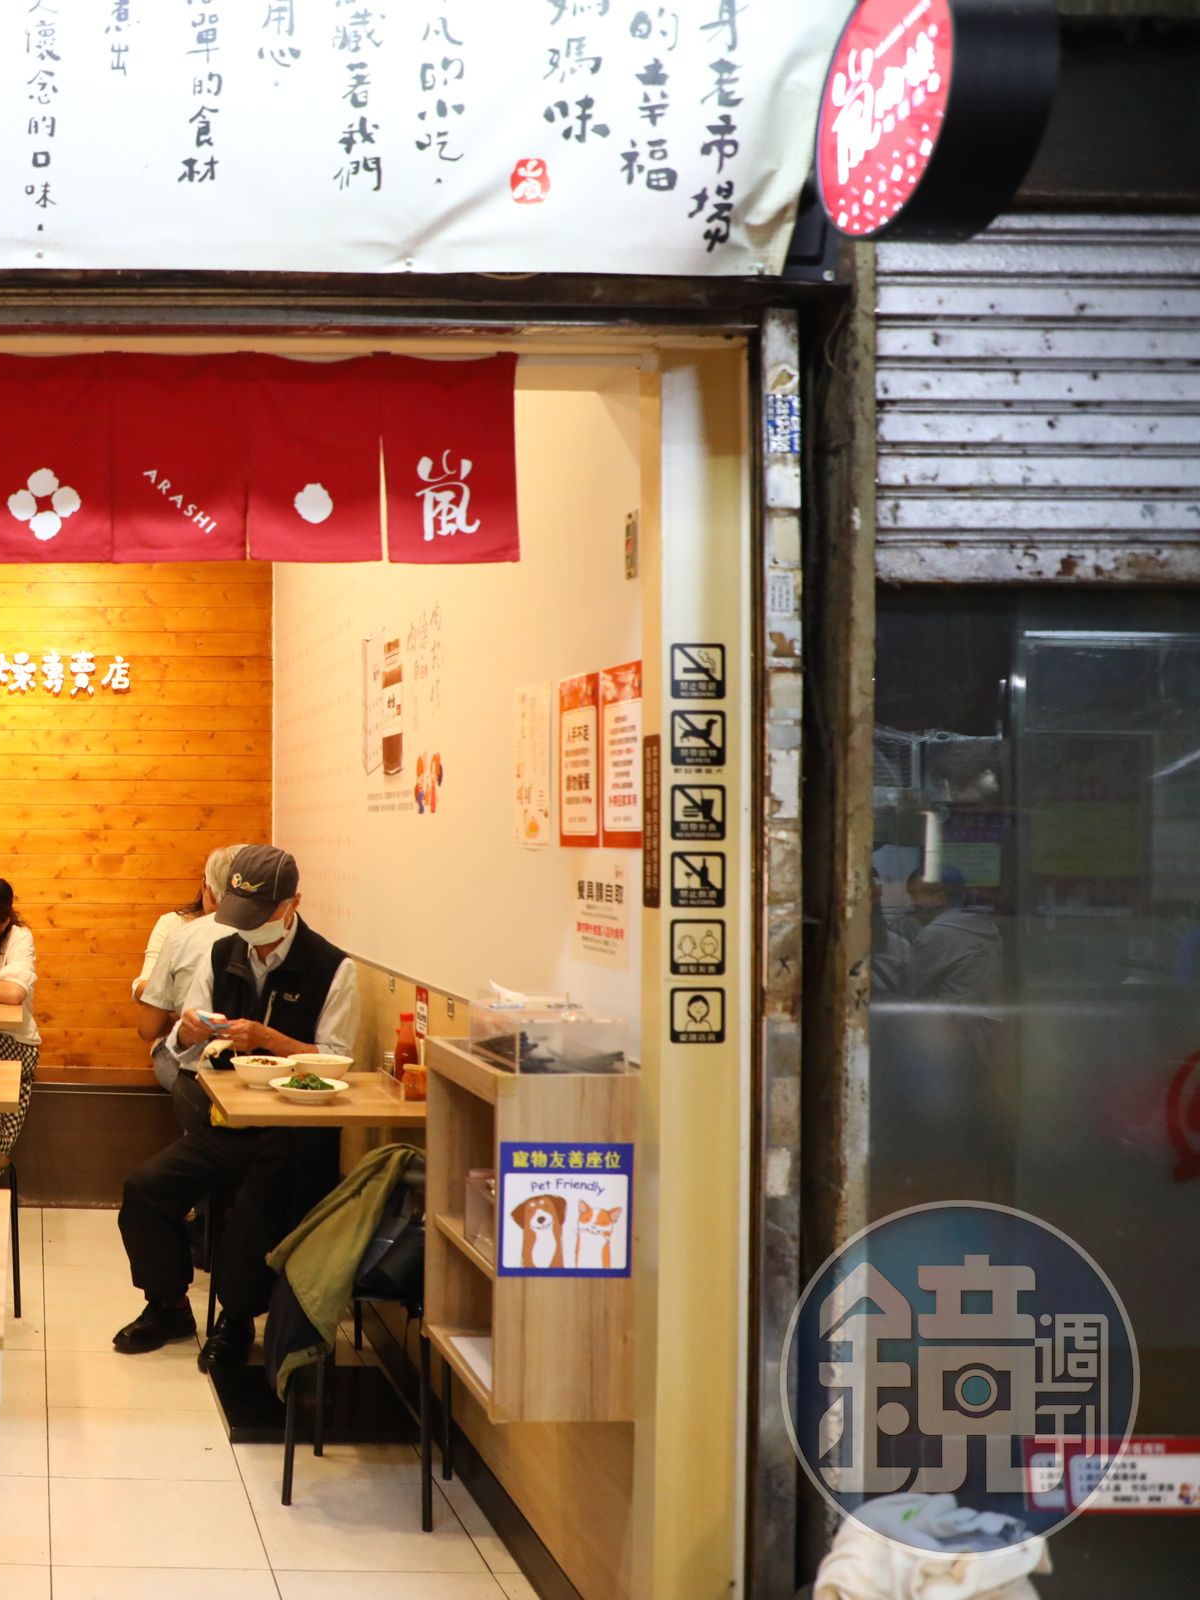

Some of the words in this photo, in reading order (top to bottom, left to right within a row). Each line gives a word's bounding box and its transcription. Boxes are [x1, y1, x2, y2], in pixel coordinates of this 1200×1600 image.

[143, 468, 218, 535] ARASHI
[415, 449, 481, 542] 嵐
[511, 1150, 621, 1169] 寵物友善座位
[530, 1179, 551, 1192] Pet
[555, 1178, 605, 1196] Friendly
